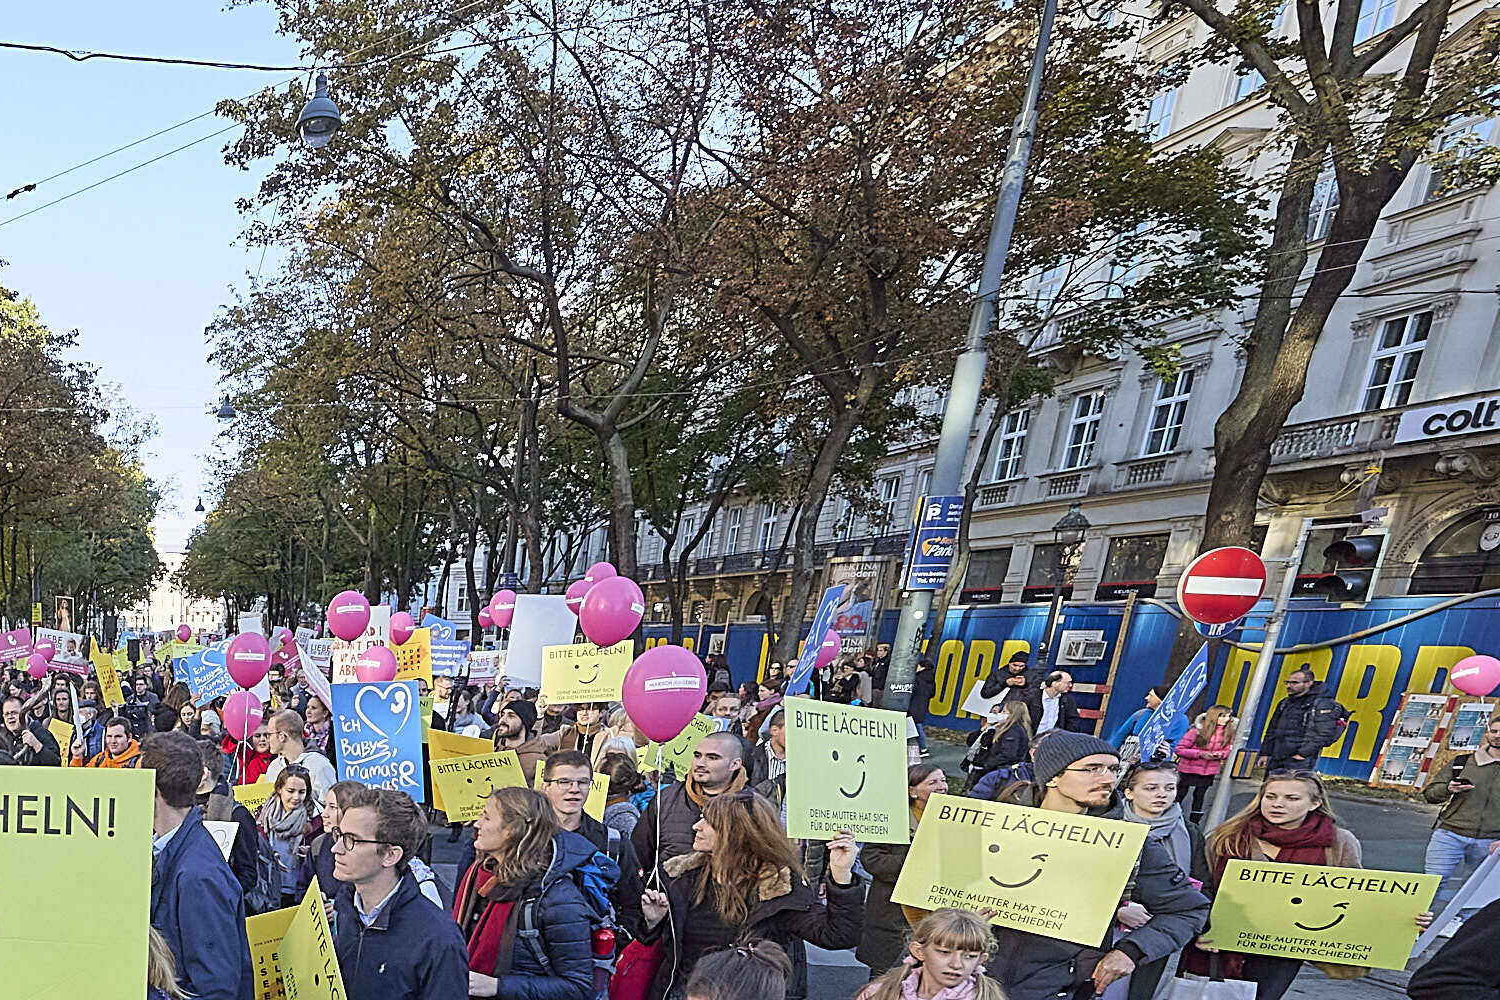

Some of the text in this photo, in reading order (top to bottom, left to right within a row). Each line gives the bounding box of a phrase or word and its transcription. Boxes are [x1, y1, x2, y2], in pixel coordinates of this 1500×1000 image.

[549, 646, 626, 659] BITTE LÄCHELN!
[796, 710, 898, 740] BITTE LÄCHELN!
[437, 756, 512, 774] BITTE LÄCHELN!
[810, 808, 889, 822] DEINE MUTTER HAT SICH
[810, 820, 889, 834] FÜR DICH ENTSCHIEDEN
[939, 805, 1125, 849] BITTE LÄCHELN!
[1239, 868, 1419, 896] BITTE LÄCHELN!
[927, 894, 948, 908] FÜR
[951, 900, 979, 912] DICH
[930, 884, 1069, 921] DEINE MUTTER HAT SICH
[309, 899, 328, 957] BITTE
[1236, 938, 1369, 961] FÜR DICH ENTSCHIEDEN
[1238, 931, 1373, 952] DEINE MUTTER HAT SICH
